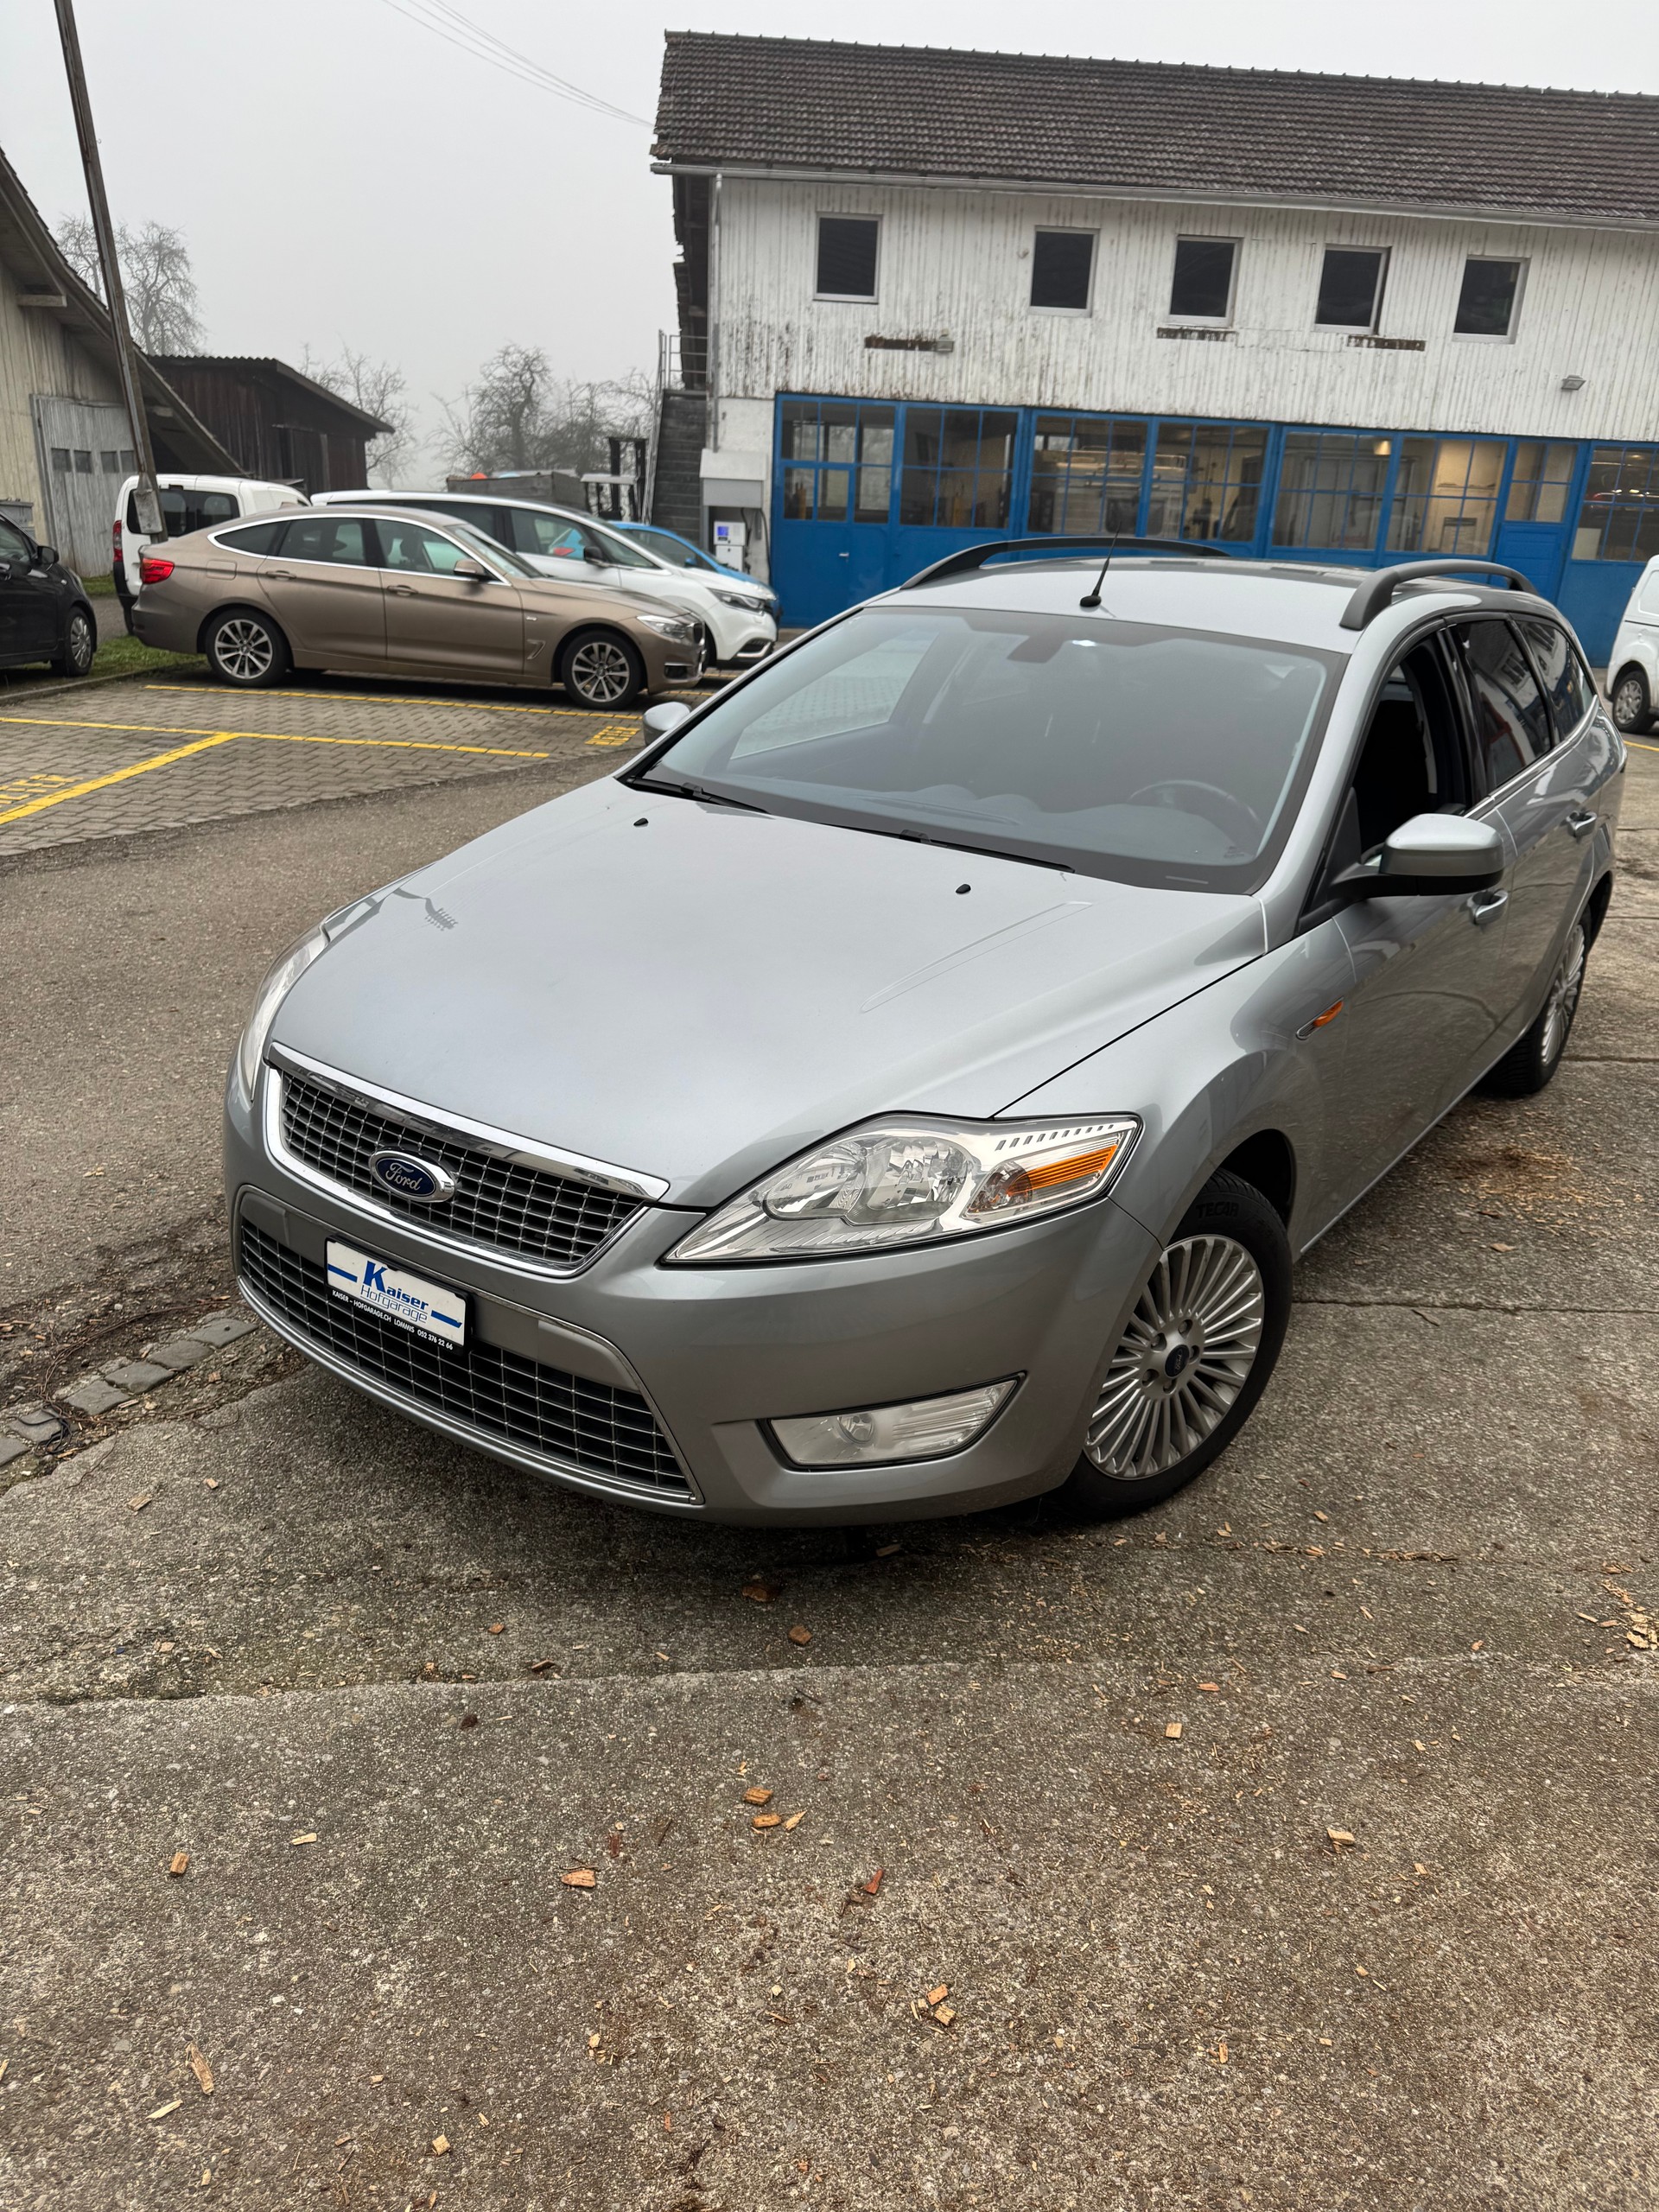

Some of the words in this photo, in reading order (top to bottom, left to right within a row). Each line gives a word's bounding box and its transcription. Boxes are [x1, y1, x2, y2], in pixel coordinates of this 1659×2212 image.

[385, 1162, 423, 1191] Ford
[363, 1261, 429, 1310] Kaiser
[360, 1285, 428, 1323] Hofgarage
[417, 1329, 428, 1339] 052
[428, 1333, 437, 1344] 376
[438, 1338, 445, 1347] 22
[446, 1342, 454, 1351] 66
